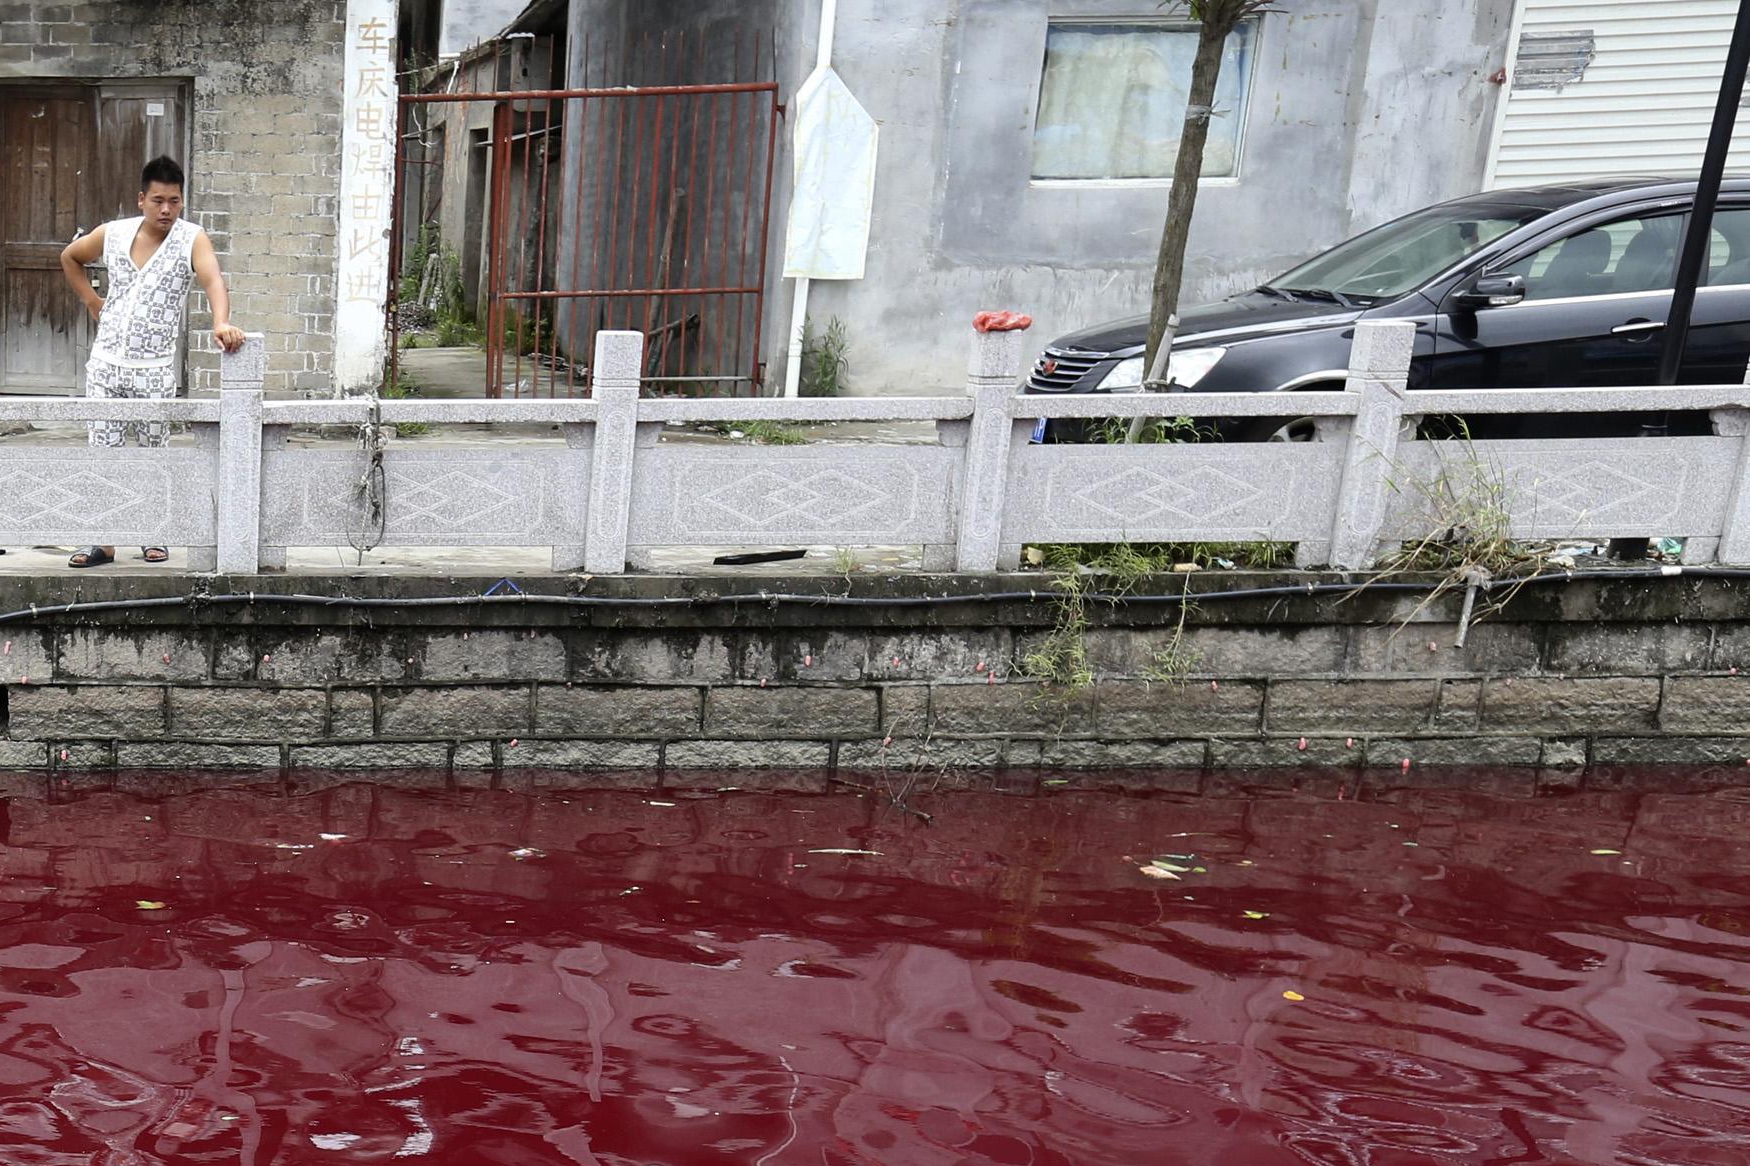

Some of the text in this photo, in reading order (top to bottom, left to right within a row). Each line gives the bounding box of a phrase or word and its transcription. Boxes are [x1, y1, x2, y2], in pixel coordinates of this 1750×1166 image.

[346, 17, 390, 303] 车床电焊由此进
